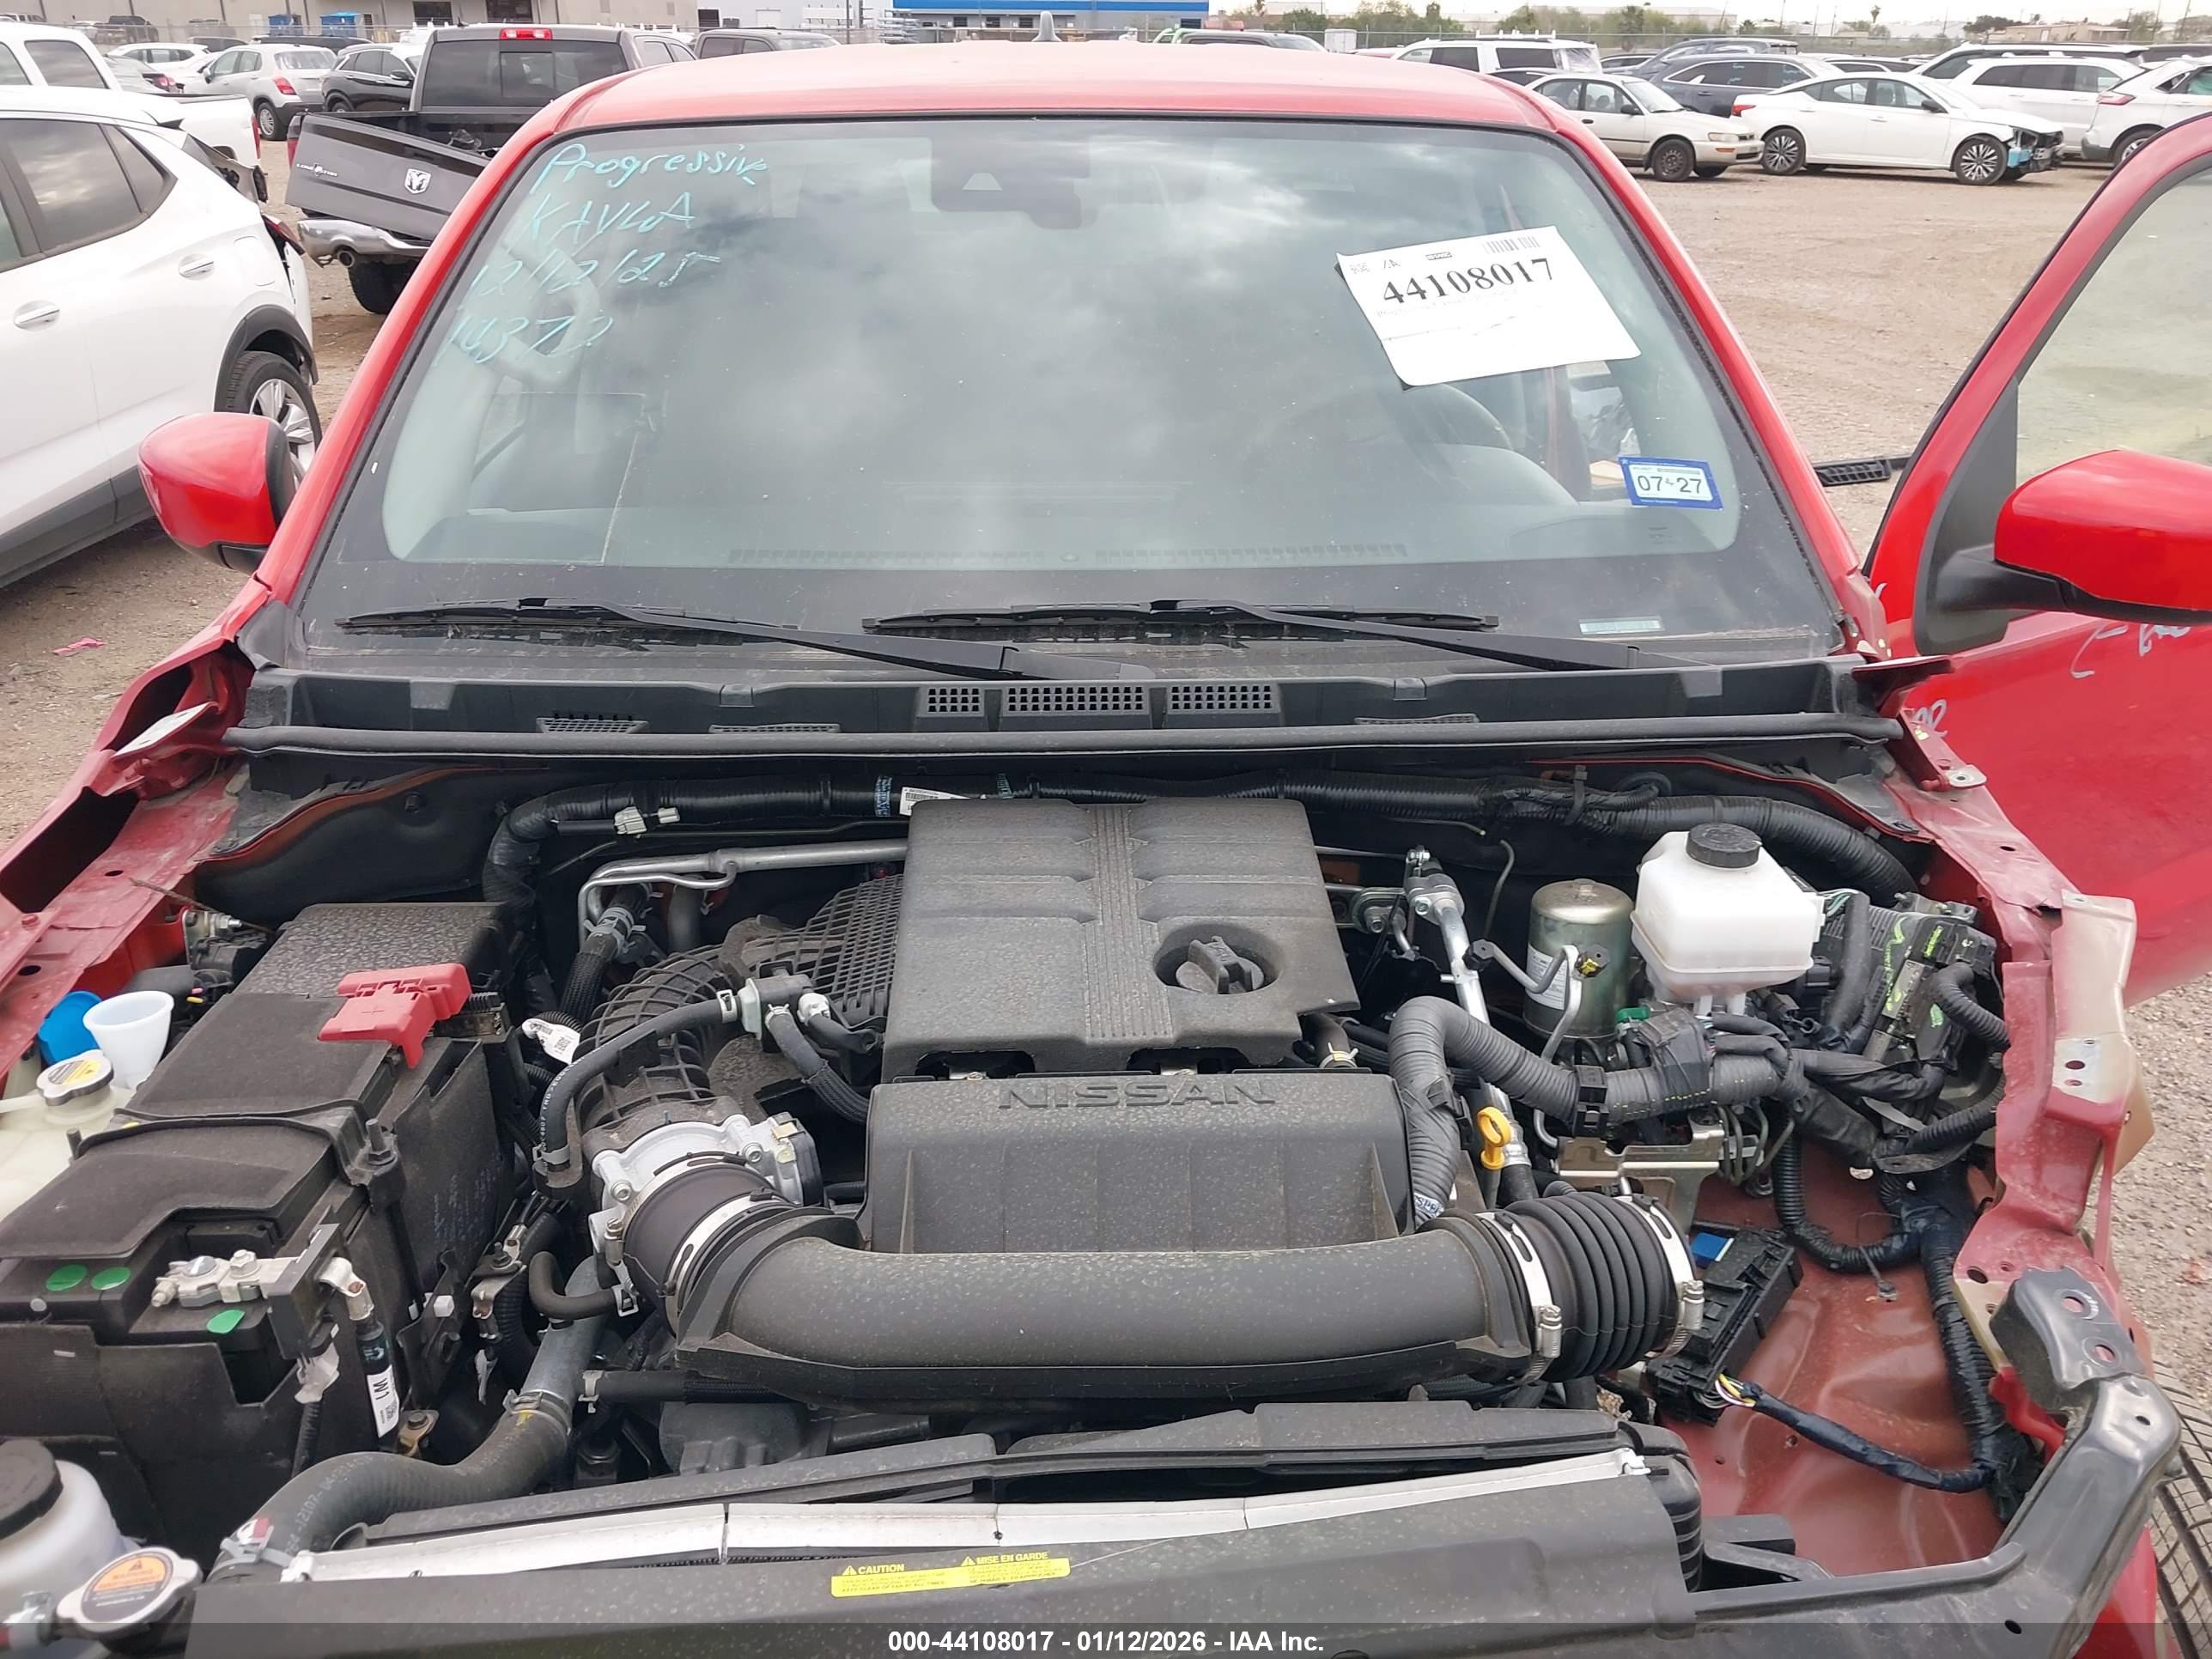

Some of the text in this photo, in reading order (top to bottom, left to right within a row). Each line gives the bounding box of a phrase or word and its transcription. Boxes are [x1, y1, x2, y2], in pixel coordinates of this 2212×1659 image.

[1382, 258, 1553, 304] 44108017
[1637, 475, 1702, 494] 07 27
[998, 1079, 1275, 1109] NISSAN
[975, 1552, 1048, 1565] MISE EN GARDE
[858, 1564, 905, 1575] CAUTION
